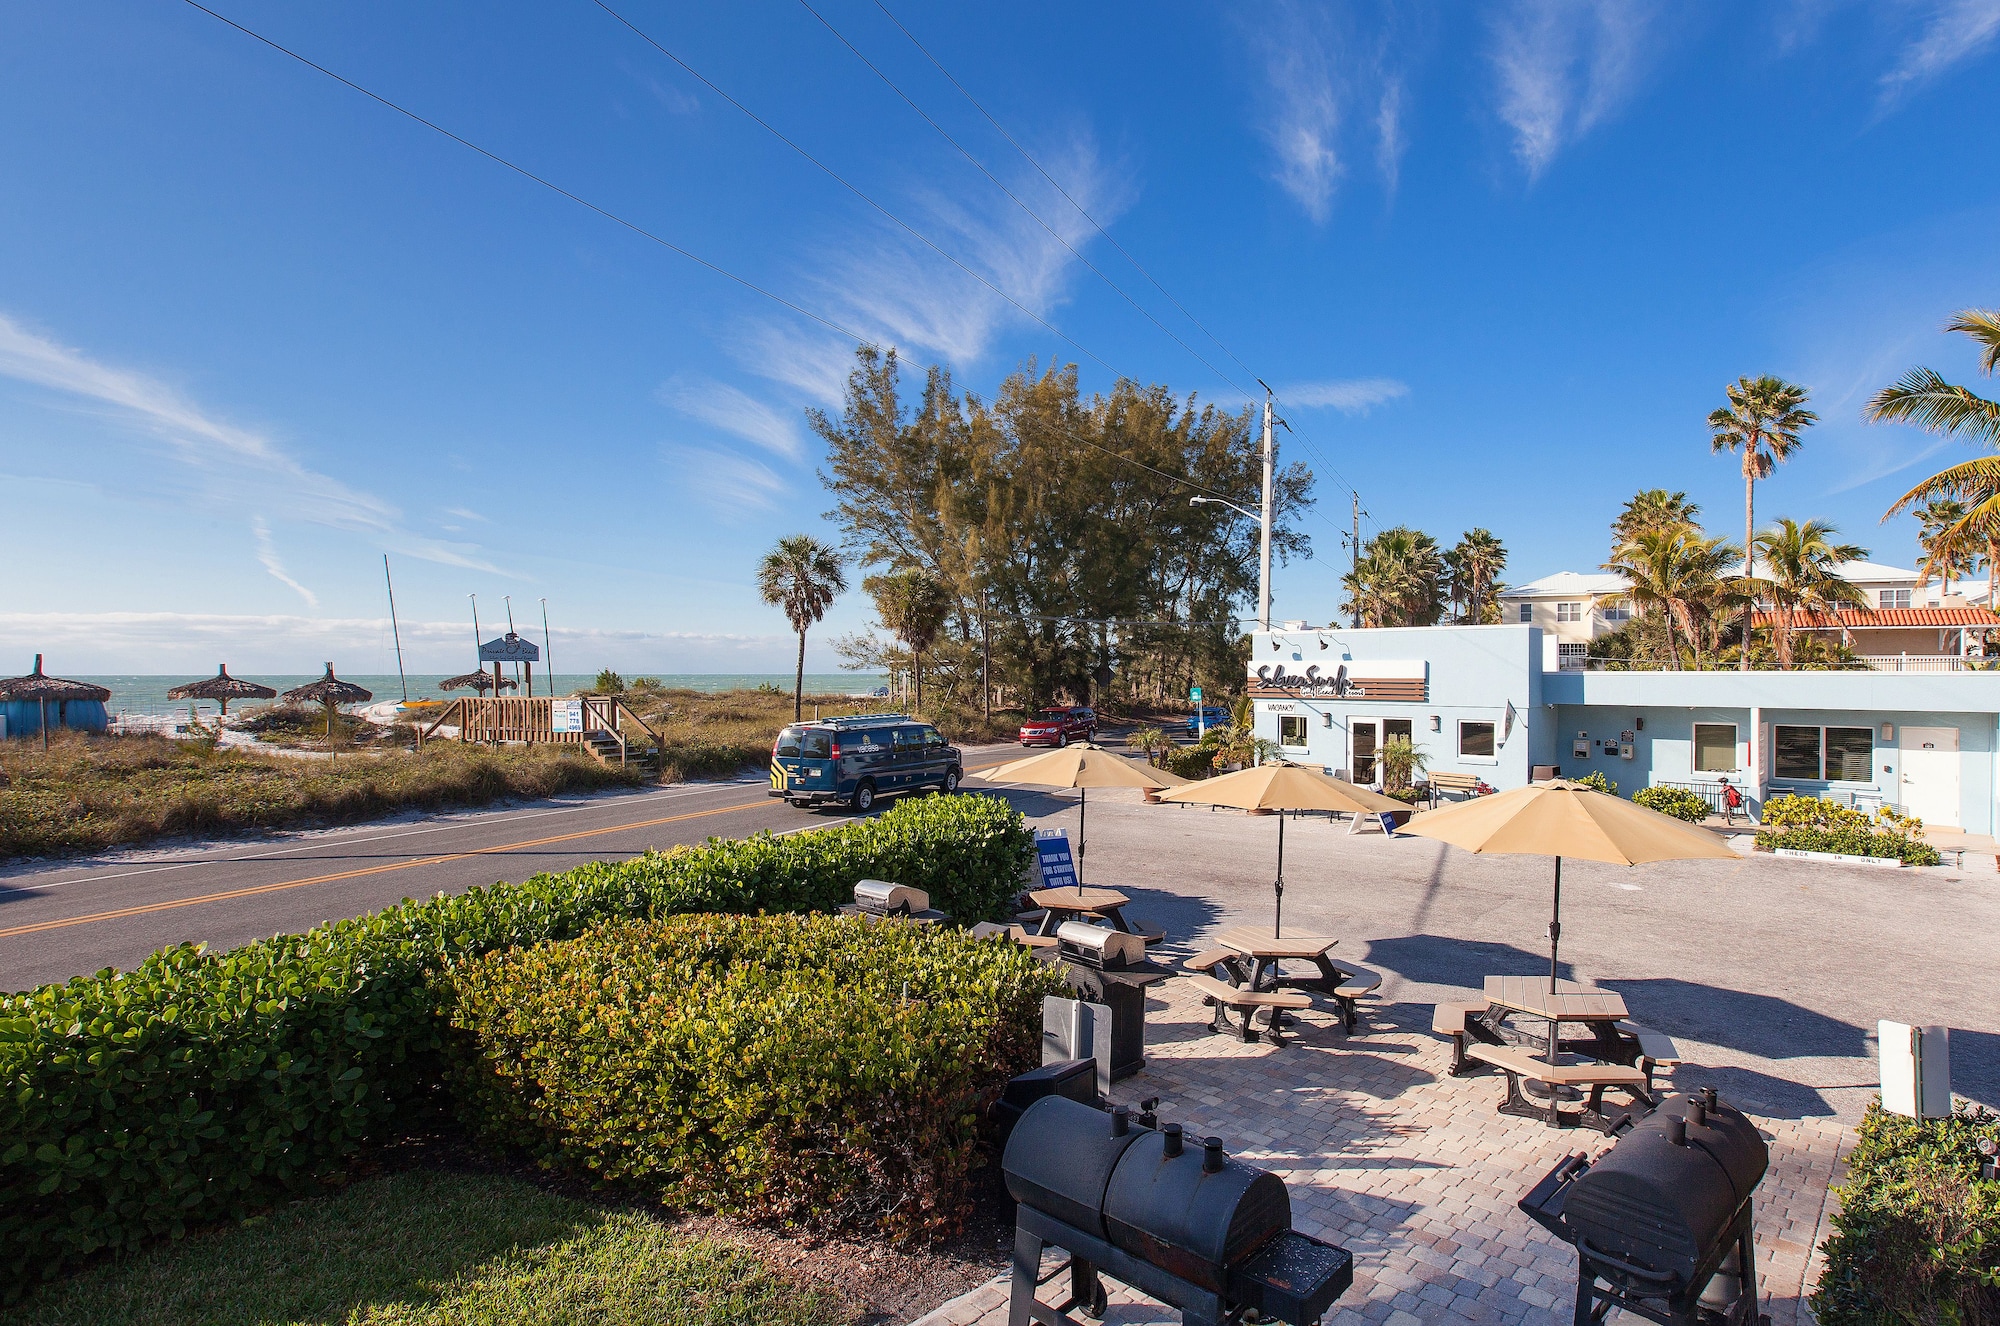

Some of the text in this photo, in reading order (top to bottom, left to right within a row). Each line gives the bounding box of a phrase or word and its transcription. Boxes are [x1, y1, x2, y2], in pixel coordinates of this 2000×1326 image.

[1267, 703, 1295, 712] VACANCY
[1042, 852, 1069, 863] THANK YOU
[1043, 866, 1053, 875] FOR
[1049, 877, 1063, 886] WITH
